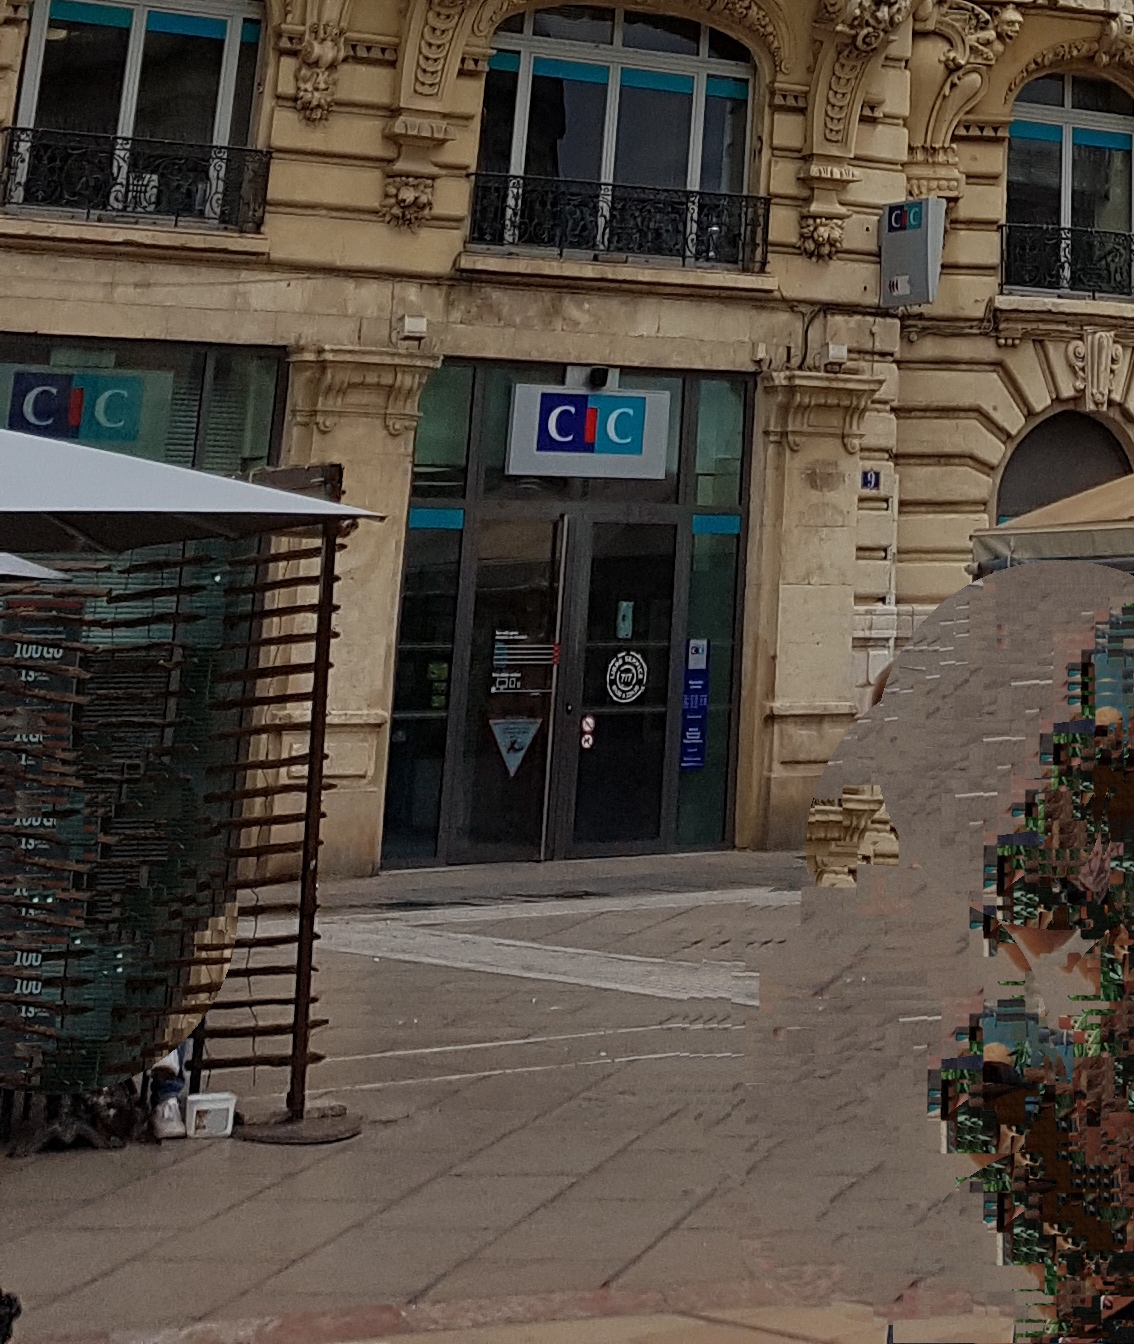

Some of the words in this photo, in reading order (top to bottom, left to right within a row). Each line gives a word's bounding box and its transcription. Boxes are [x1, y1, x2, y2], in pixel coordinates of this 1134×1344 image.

[891, 208, 919, 228] CIC
[22, 386, 128, 428] CIC
[547, 405, 634, 444] CIC
[867, 471, 876, 488] 9
